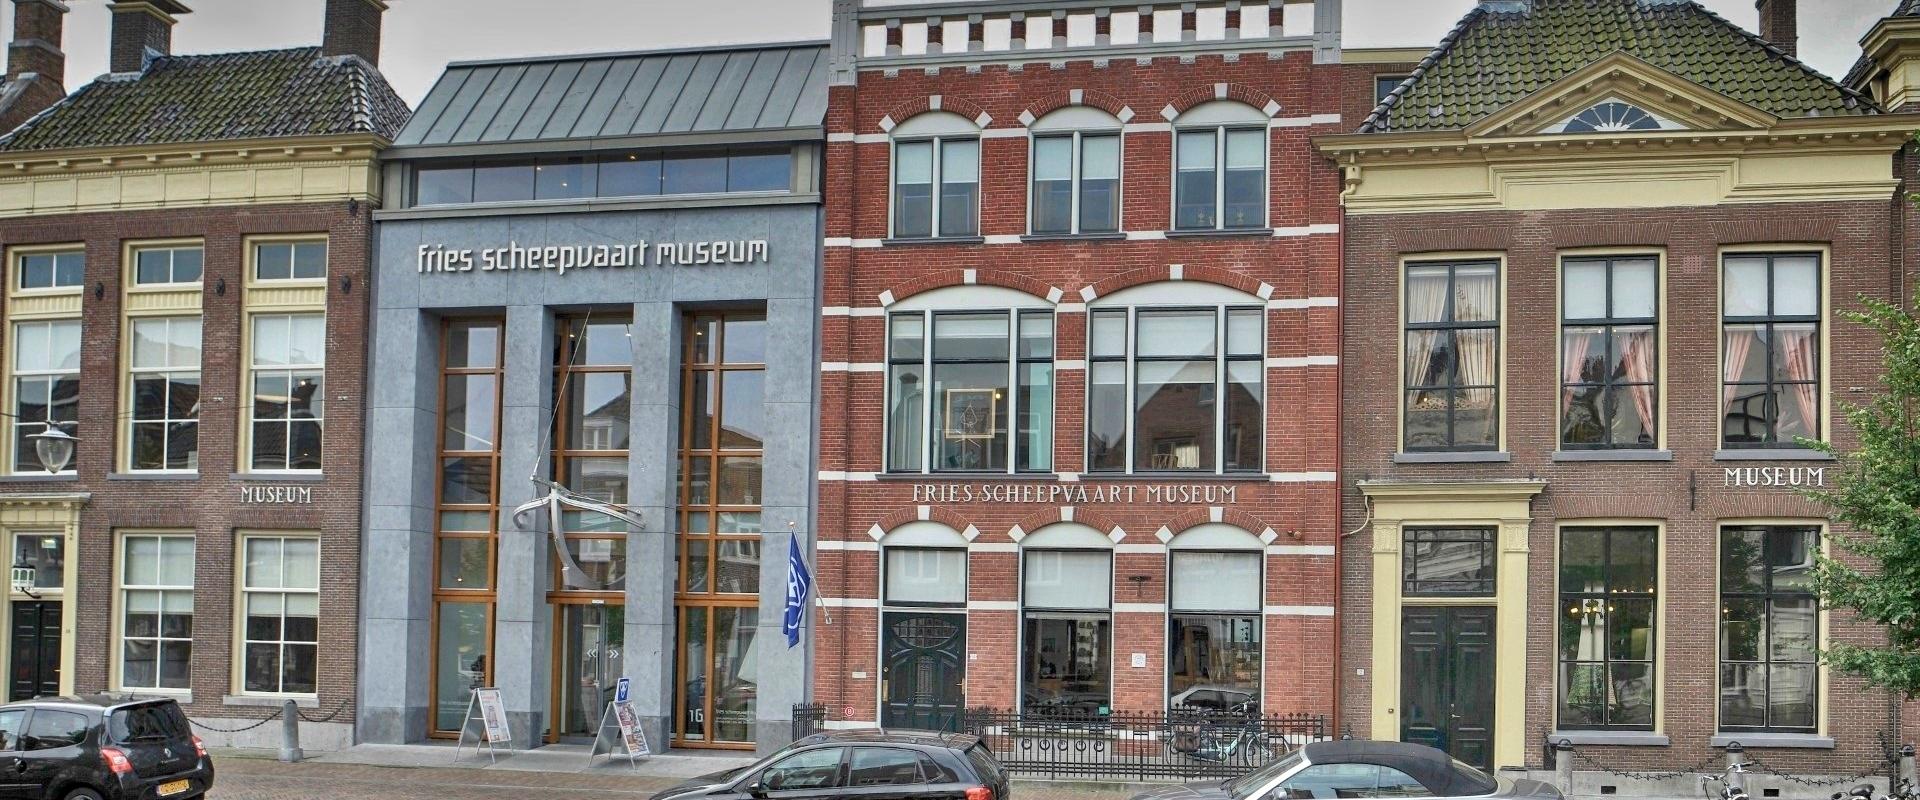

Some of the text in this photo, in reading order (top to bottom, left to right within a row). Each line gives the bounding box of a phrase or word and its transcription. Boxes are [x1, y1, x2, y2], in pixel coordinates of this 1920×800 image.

[417, 239, 768, 276] fries scheepvaart museum
[1723, 466, 1825, 487] MUSEUM
[240, 486, 312, 504] MUSEUM
[912, 484, 1237, 505] FRIES SCHEEPVAART MUSEUM
[688, 708, 704, 723] 16
